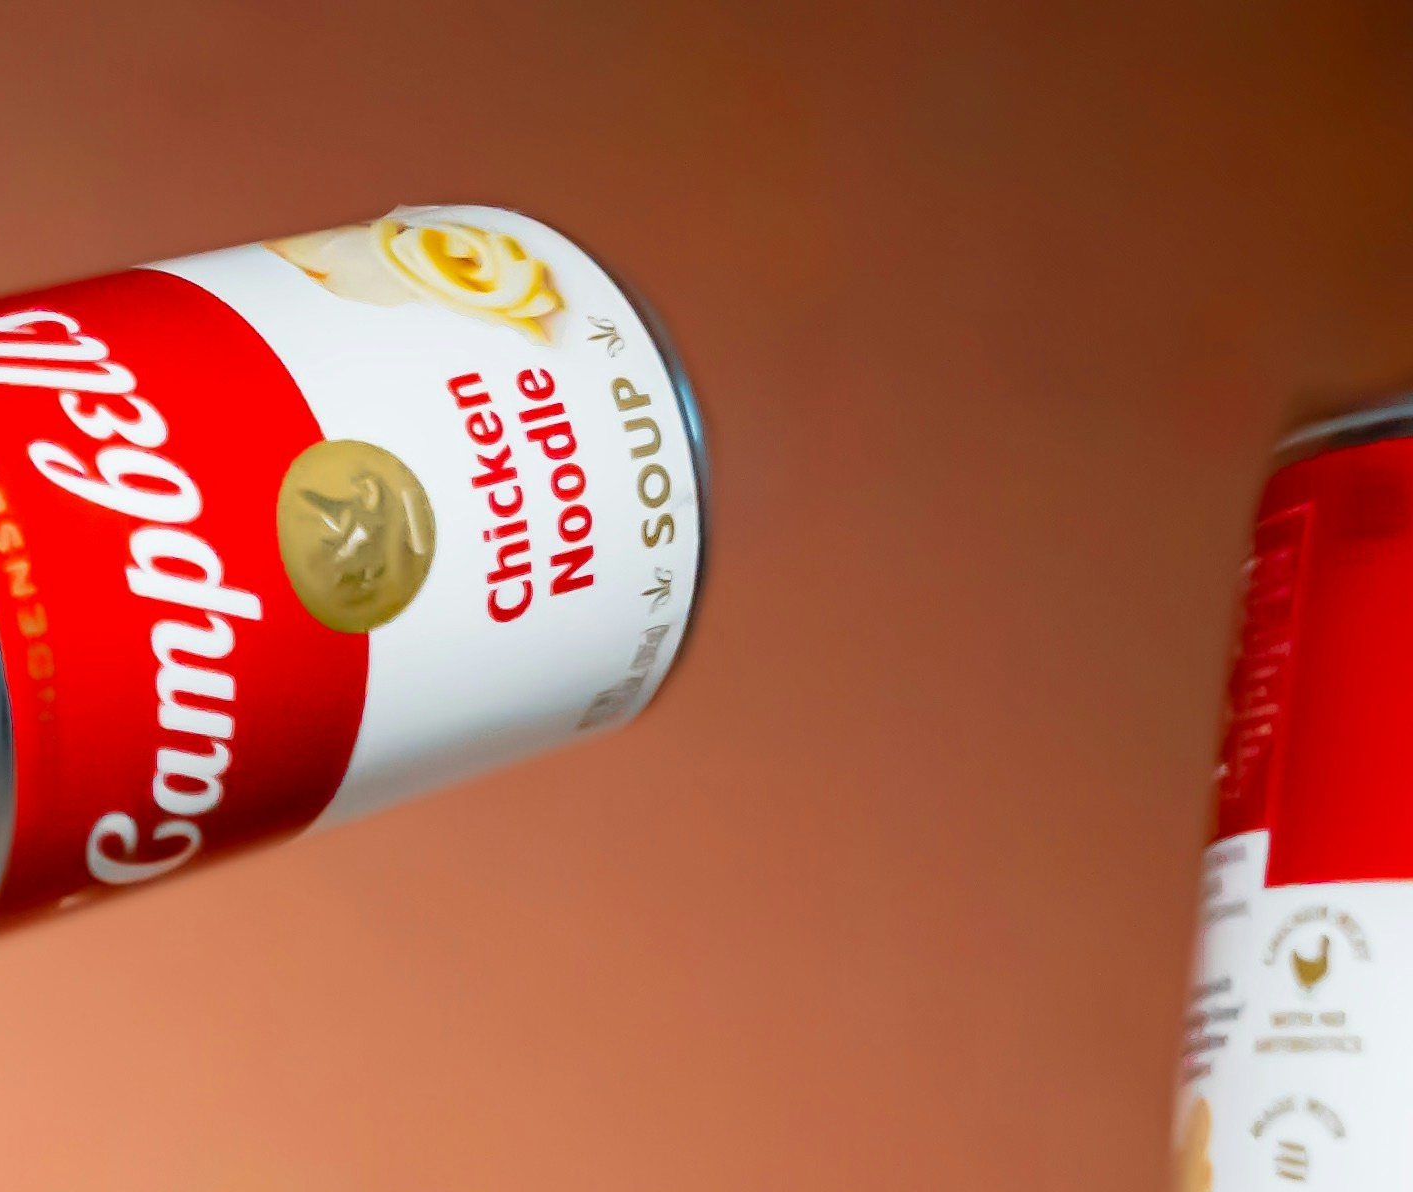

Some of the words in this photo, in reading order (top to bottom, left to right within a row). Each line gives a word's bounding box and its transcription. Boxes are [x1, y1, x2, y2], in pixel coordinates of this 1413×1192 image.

[445, 372, 533, 624] Chicken
[515, 368, 595, 597] Noodle
[610, 376, 675, 549] SOUP
